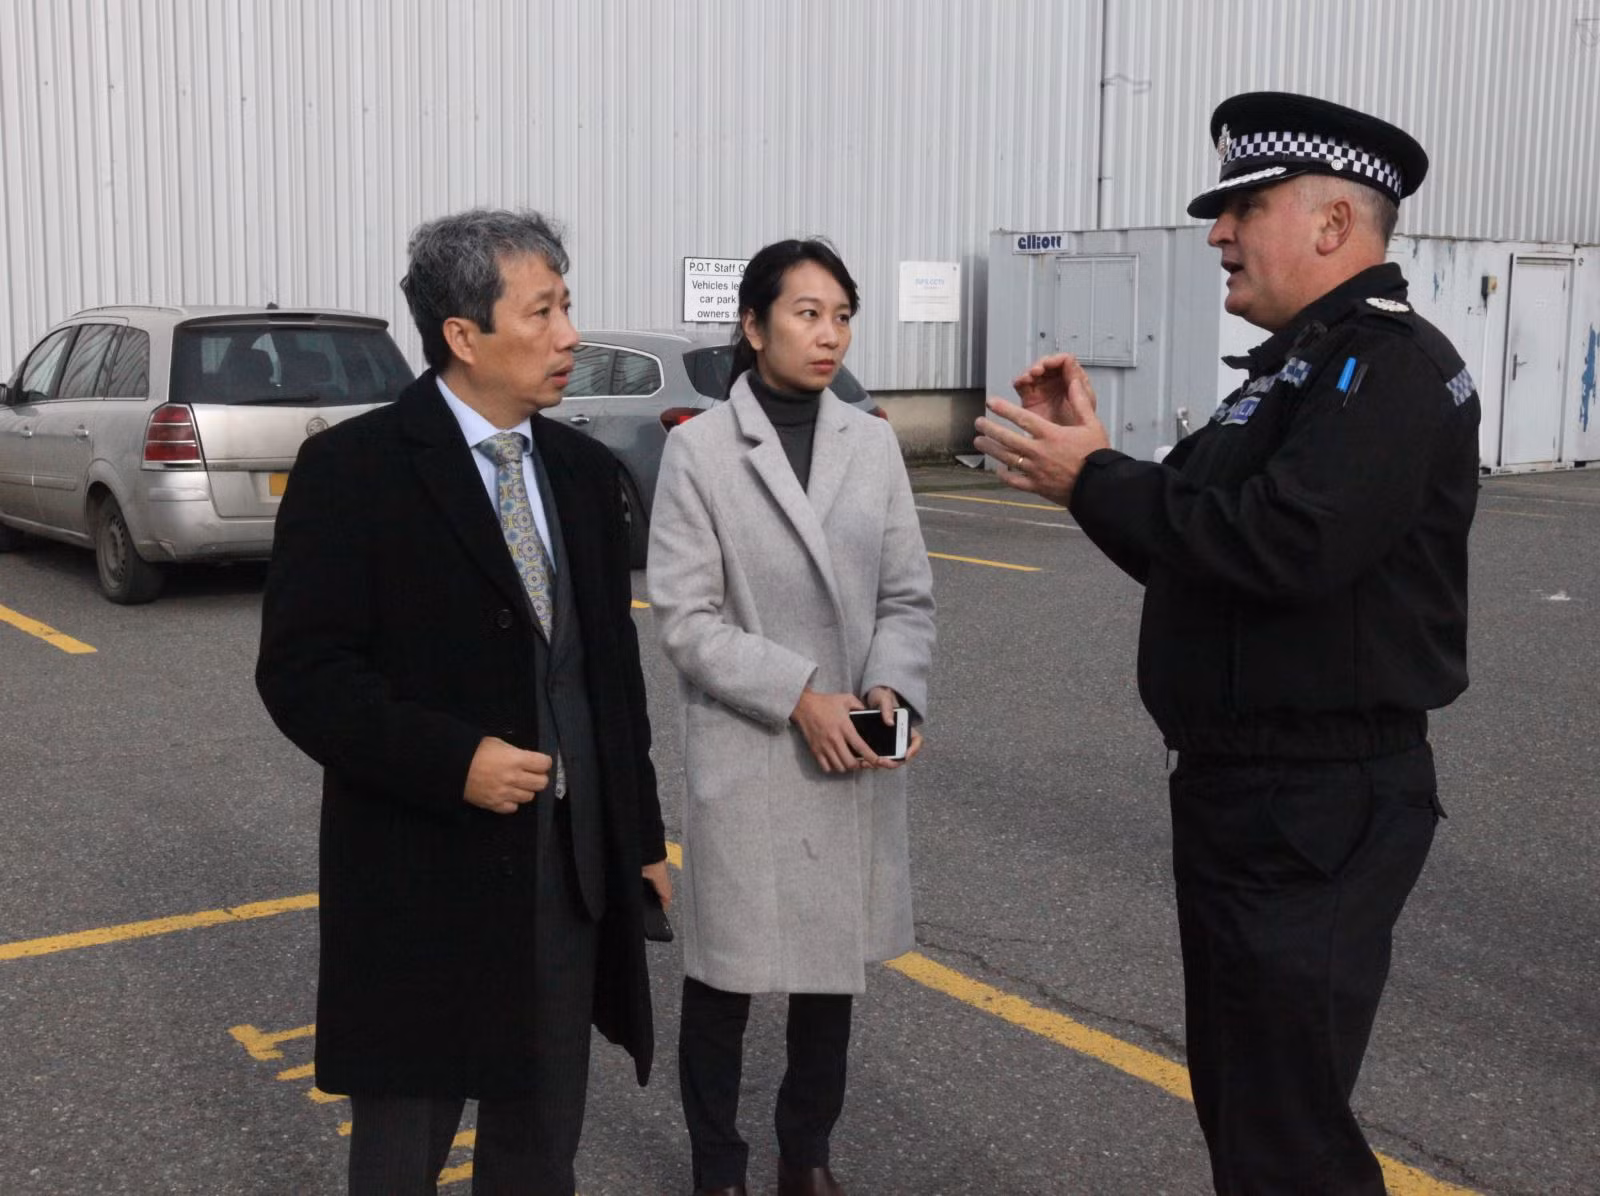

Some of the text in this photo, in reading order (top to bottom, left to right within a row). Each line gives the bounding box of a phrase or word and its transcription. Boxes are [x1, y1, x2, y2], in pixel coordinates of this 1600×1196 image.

[714, 263, 736, 273] Staff
[691, 280, 729, 290] Vehicles
[699, 295, 737, 306] car park
[697, 310, 730, 319] owners
